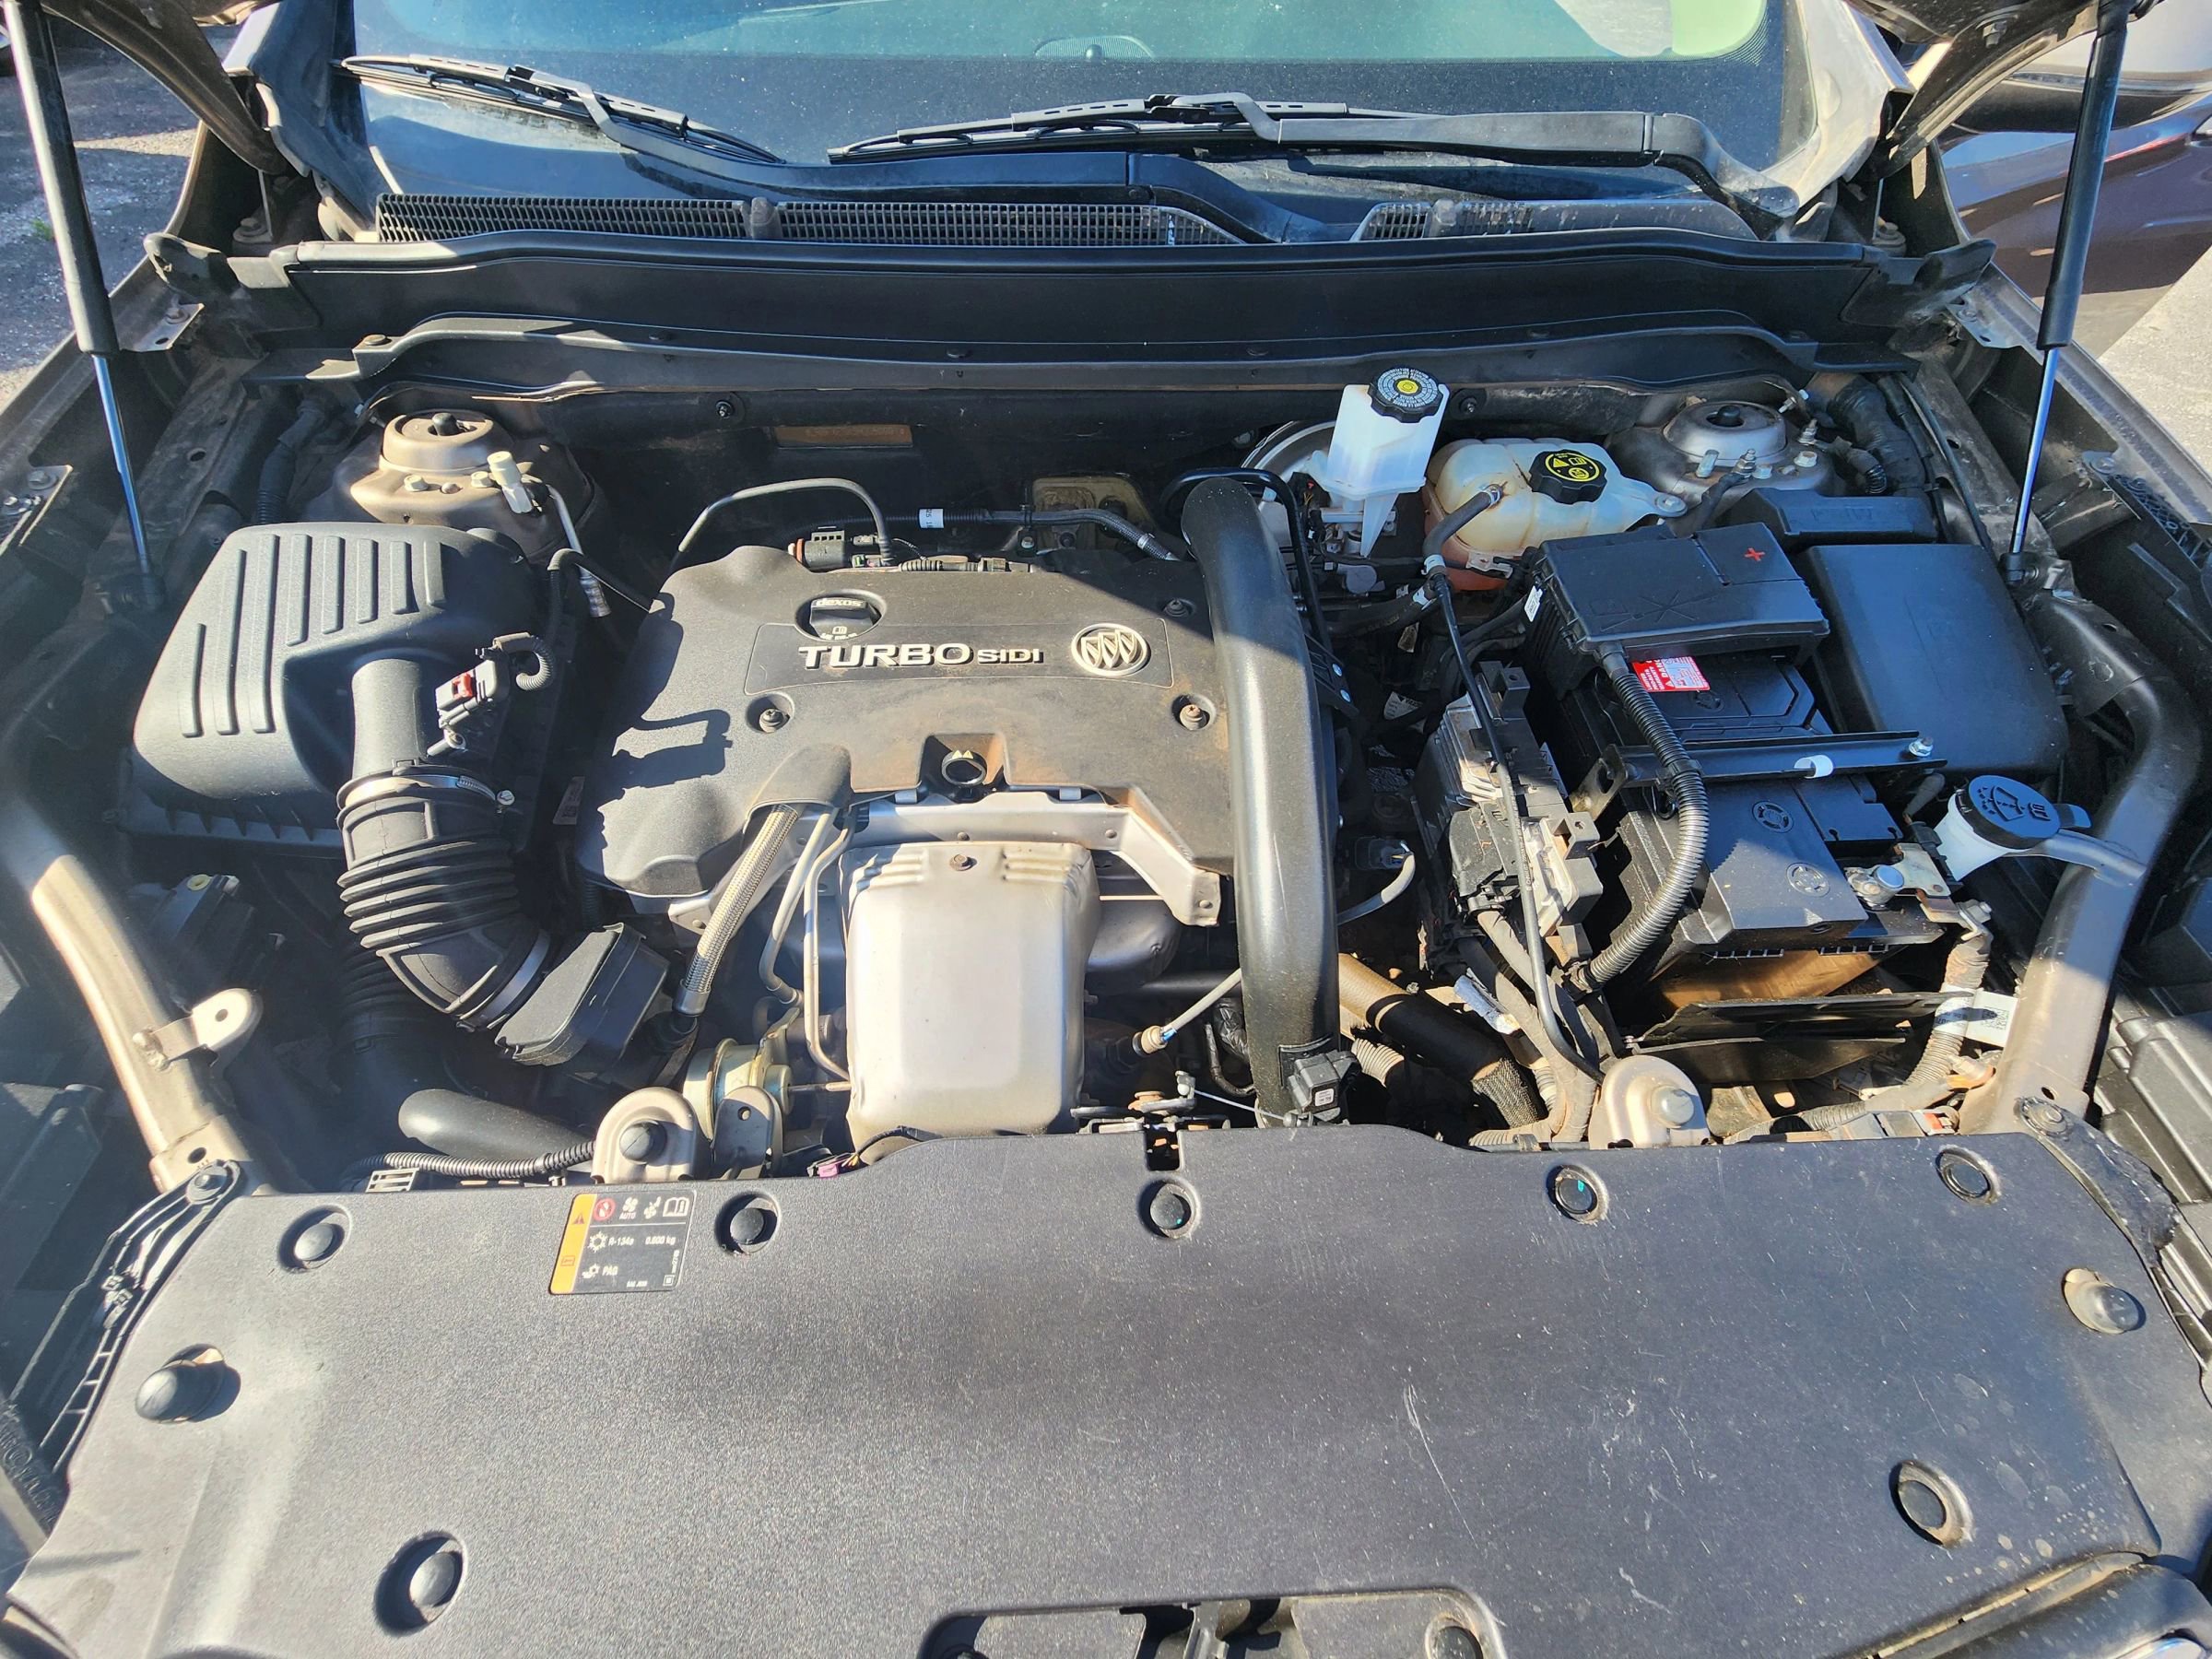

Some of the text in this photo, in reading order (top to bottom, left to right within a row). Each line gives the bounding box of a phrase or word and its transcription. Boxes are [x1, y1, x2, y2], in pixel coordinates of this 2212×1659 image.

[817, 598, 863, 607] dexos
[798, 643, 1043, 669] TURBO SIDI
